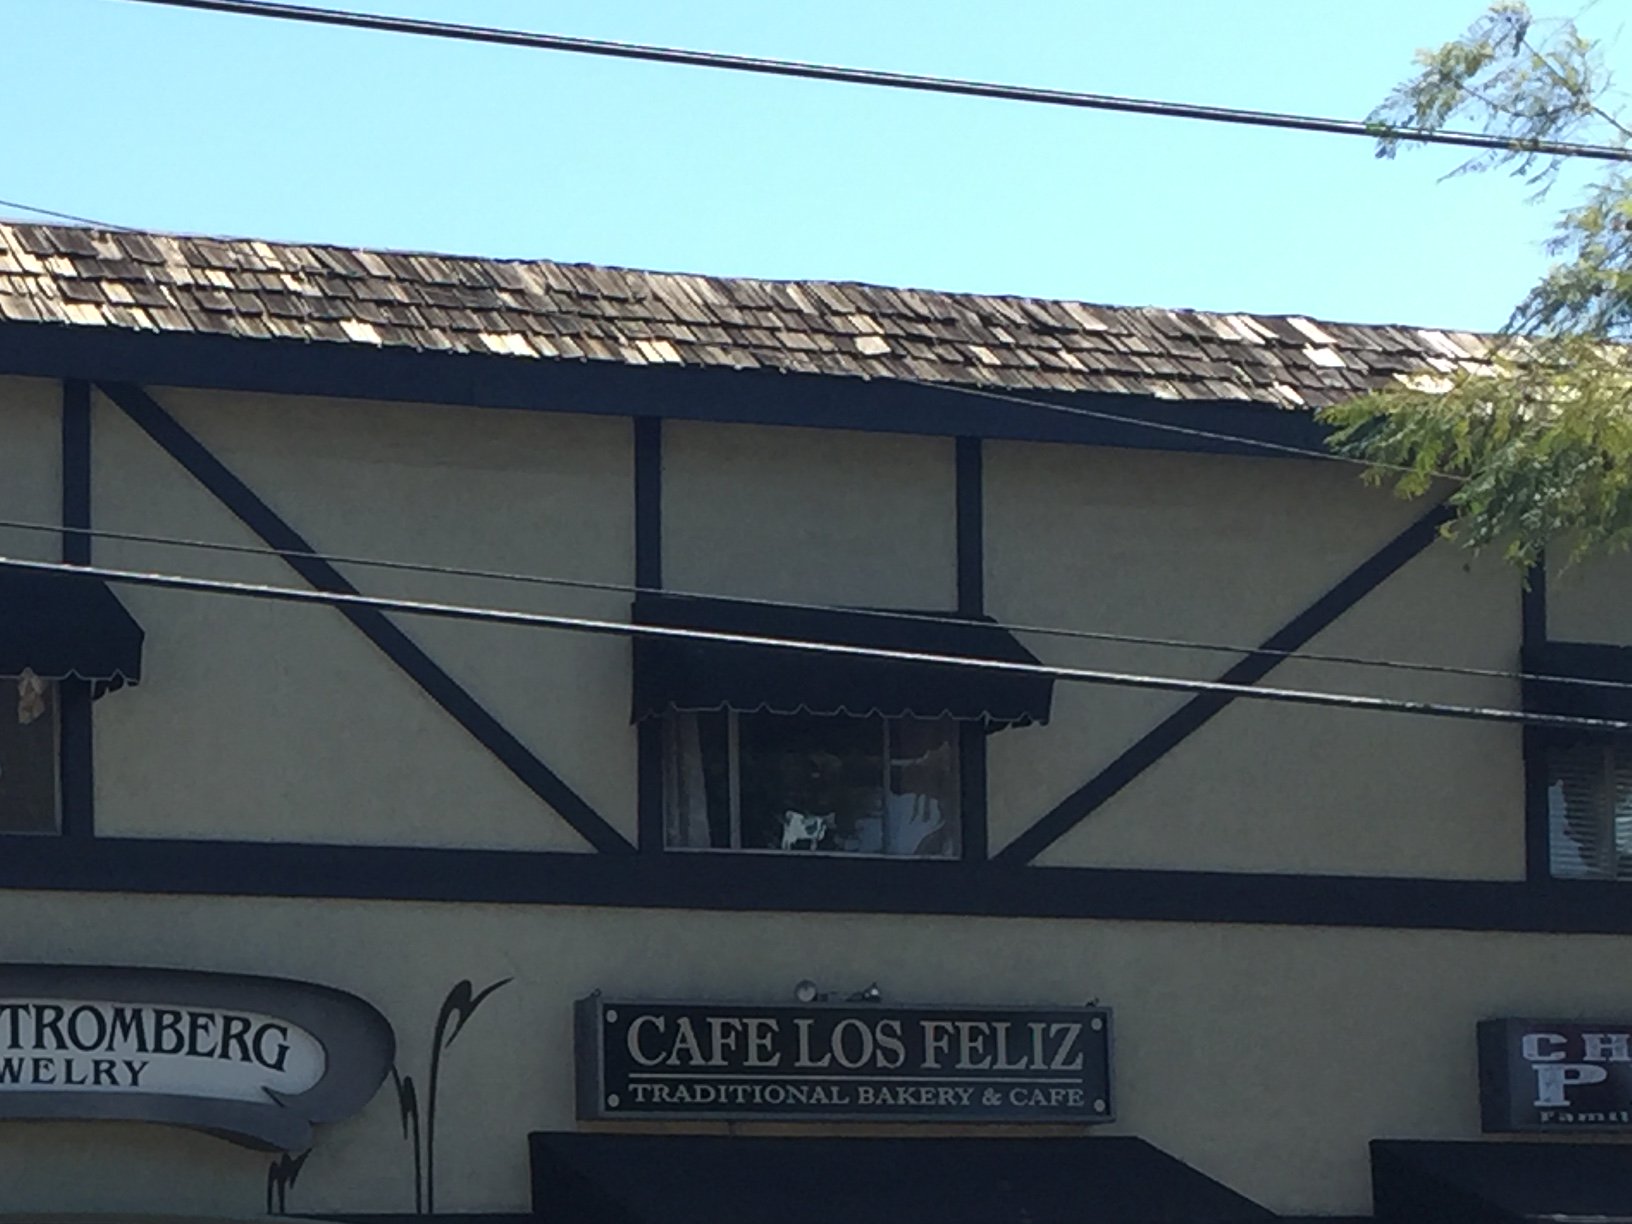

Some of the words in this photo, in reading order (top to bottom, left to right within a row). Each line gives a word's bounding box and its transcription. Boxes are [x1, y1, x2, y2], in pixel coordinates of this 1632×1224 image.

[627, 1015, 781, 1067] CAFE
[793, 1017, 905, 1069] LOS
[920, 1020, 1084, 1071] FELIZ
[628, 1083, 849, 1105] TRADITIONAL
[858, 1086, 973, 1106] BAKERY
[982, 1089, 1002, 1106] &
[1009, 1088, 1084, 1107] CAFE
[1531, 1064, 1608, 1107] P
